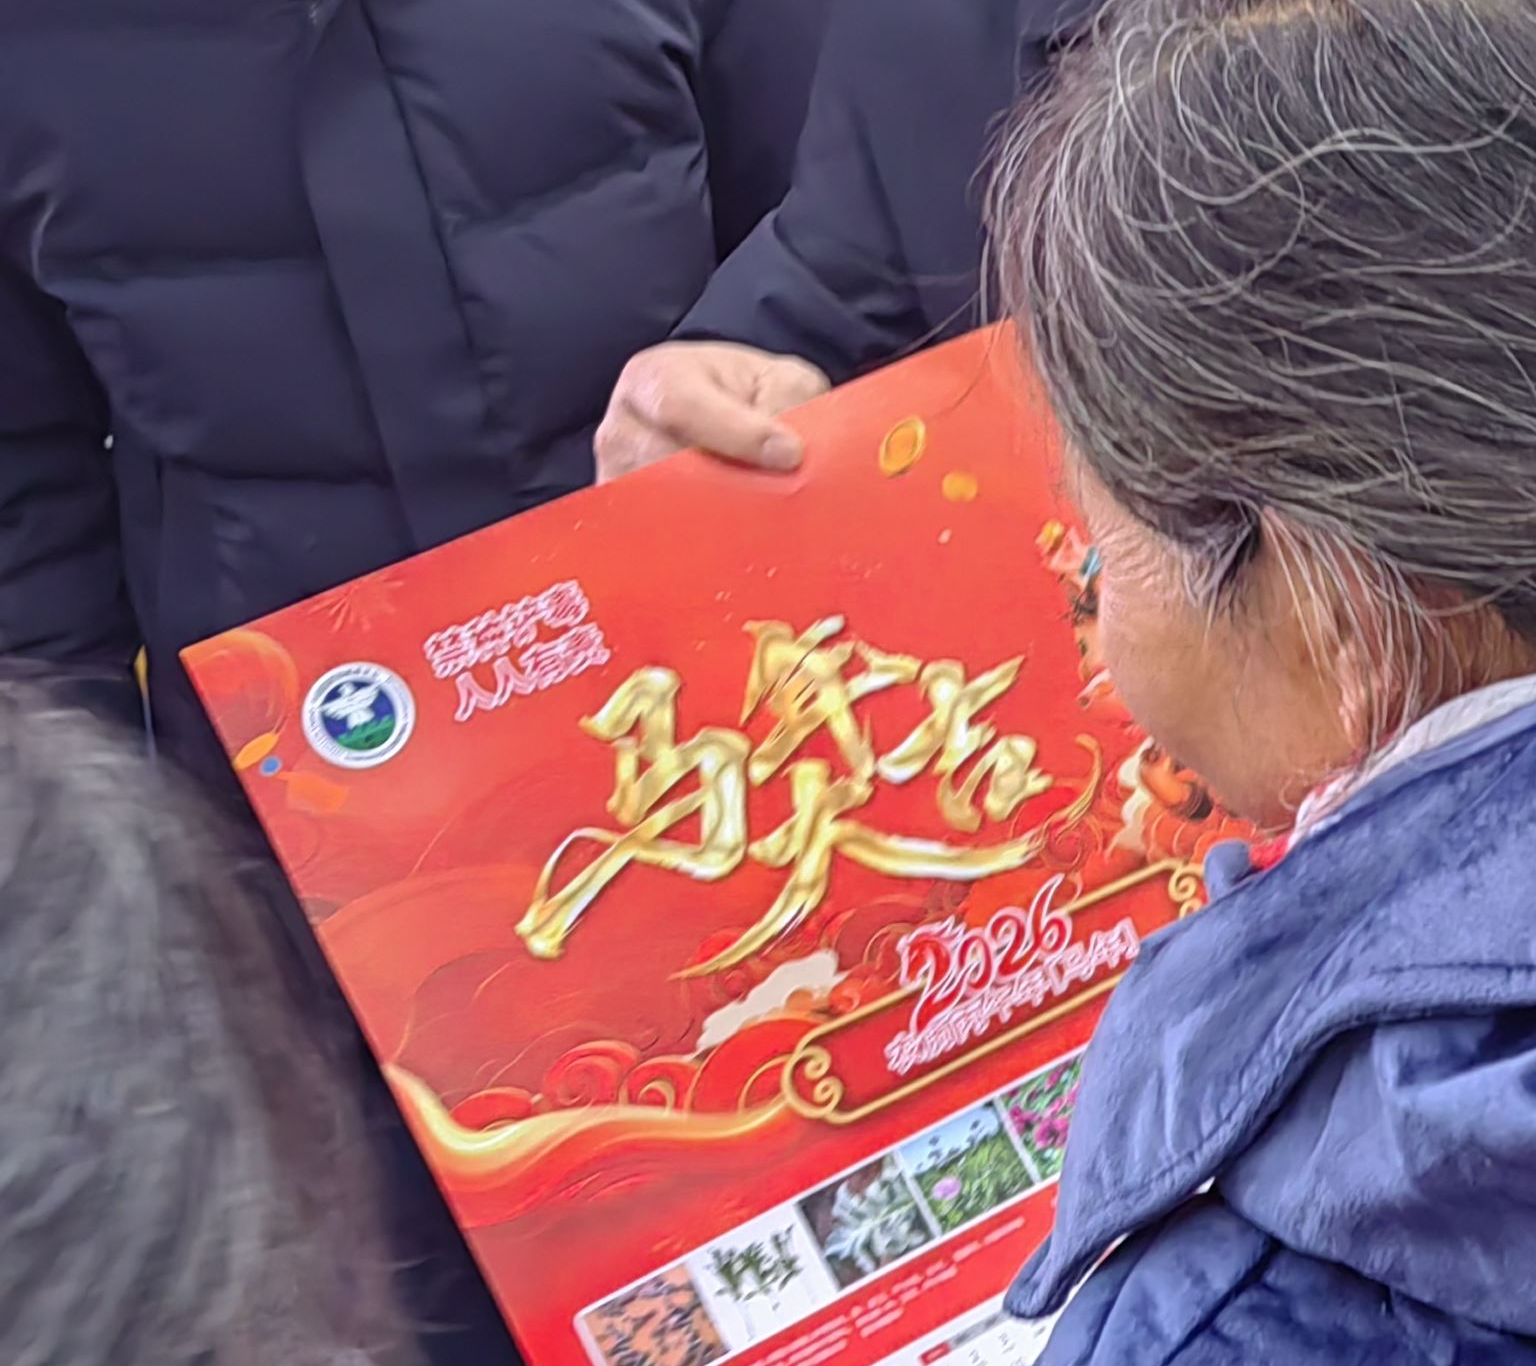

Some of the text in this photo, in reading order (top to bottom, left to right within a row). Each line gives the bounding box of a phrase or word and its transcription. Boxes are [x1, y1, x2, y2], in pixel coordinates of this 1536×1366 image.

[454, 621, 611, 722] 人人有责
[896, 873, 1073, 1035] 2026
